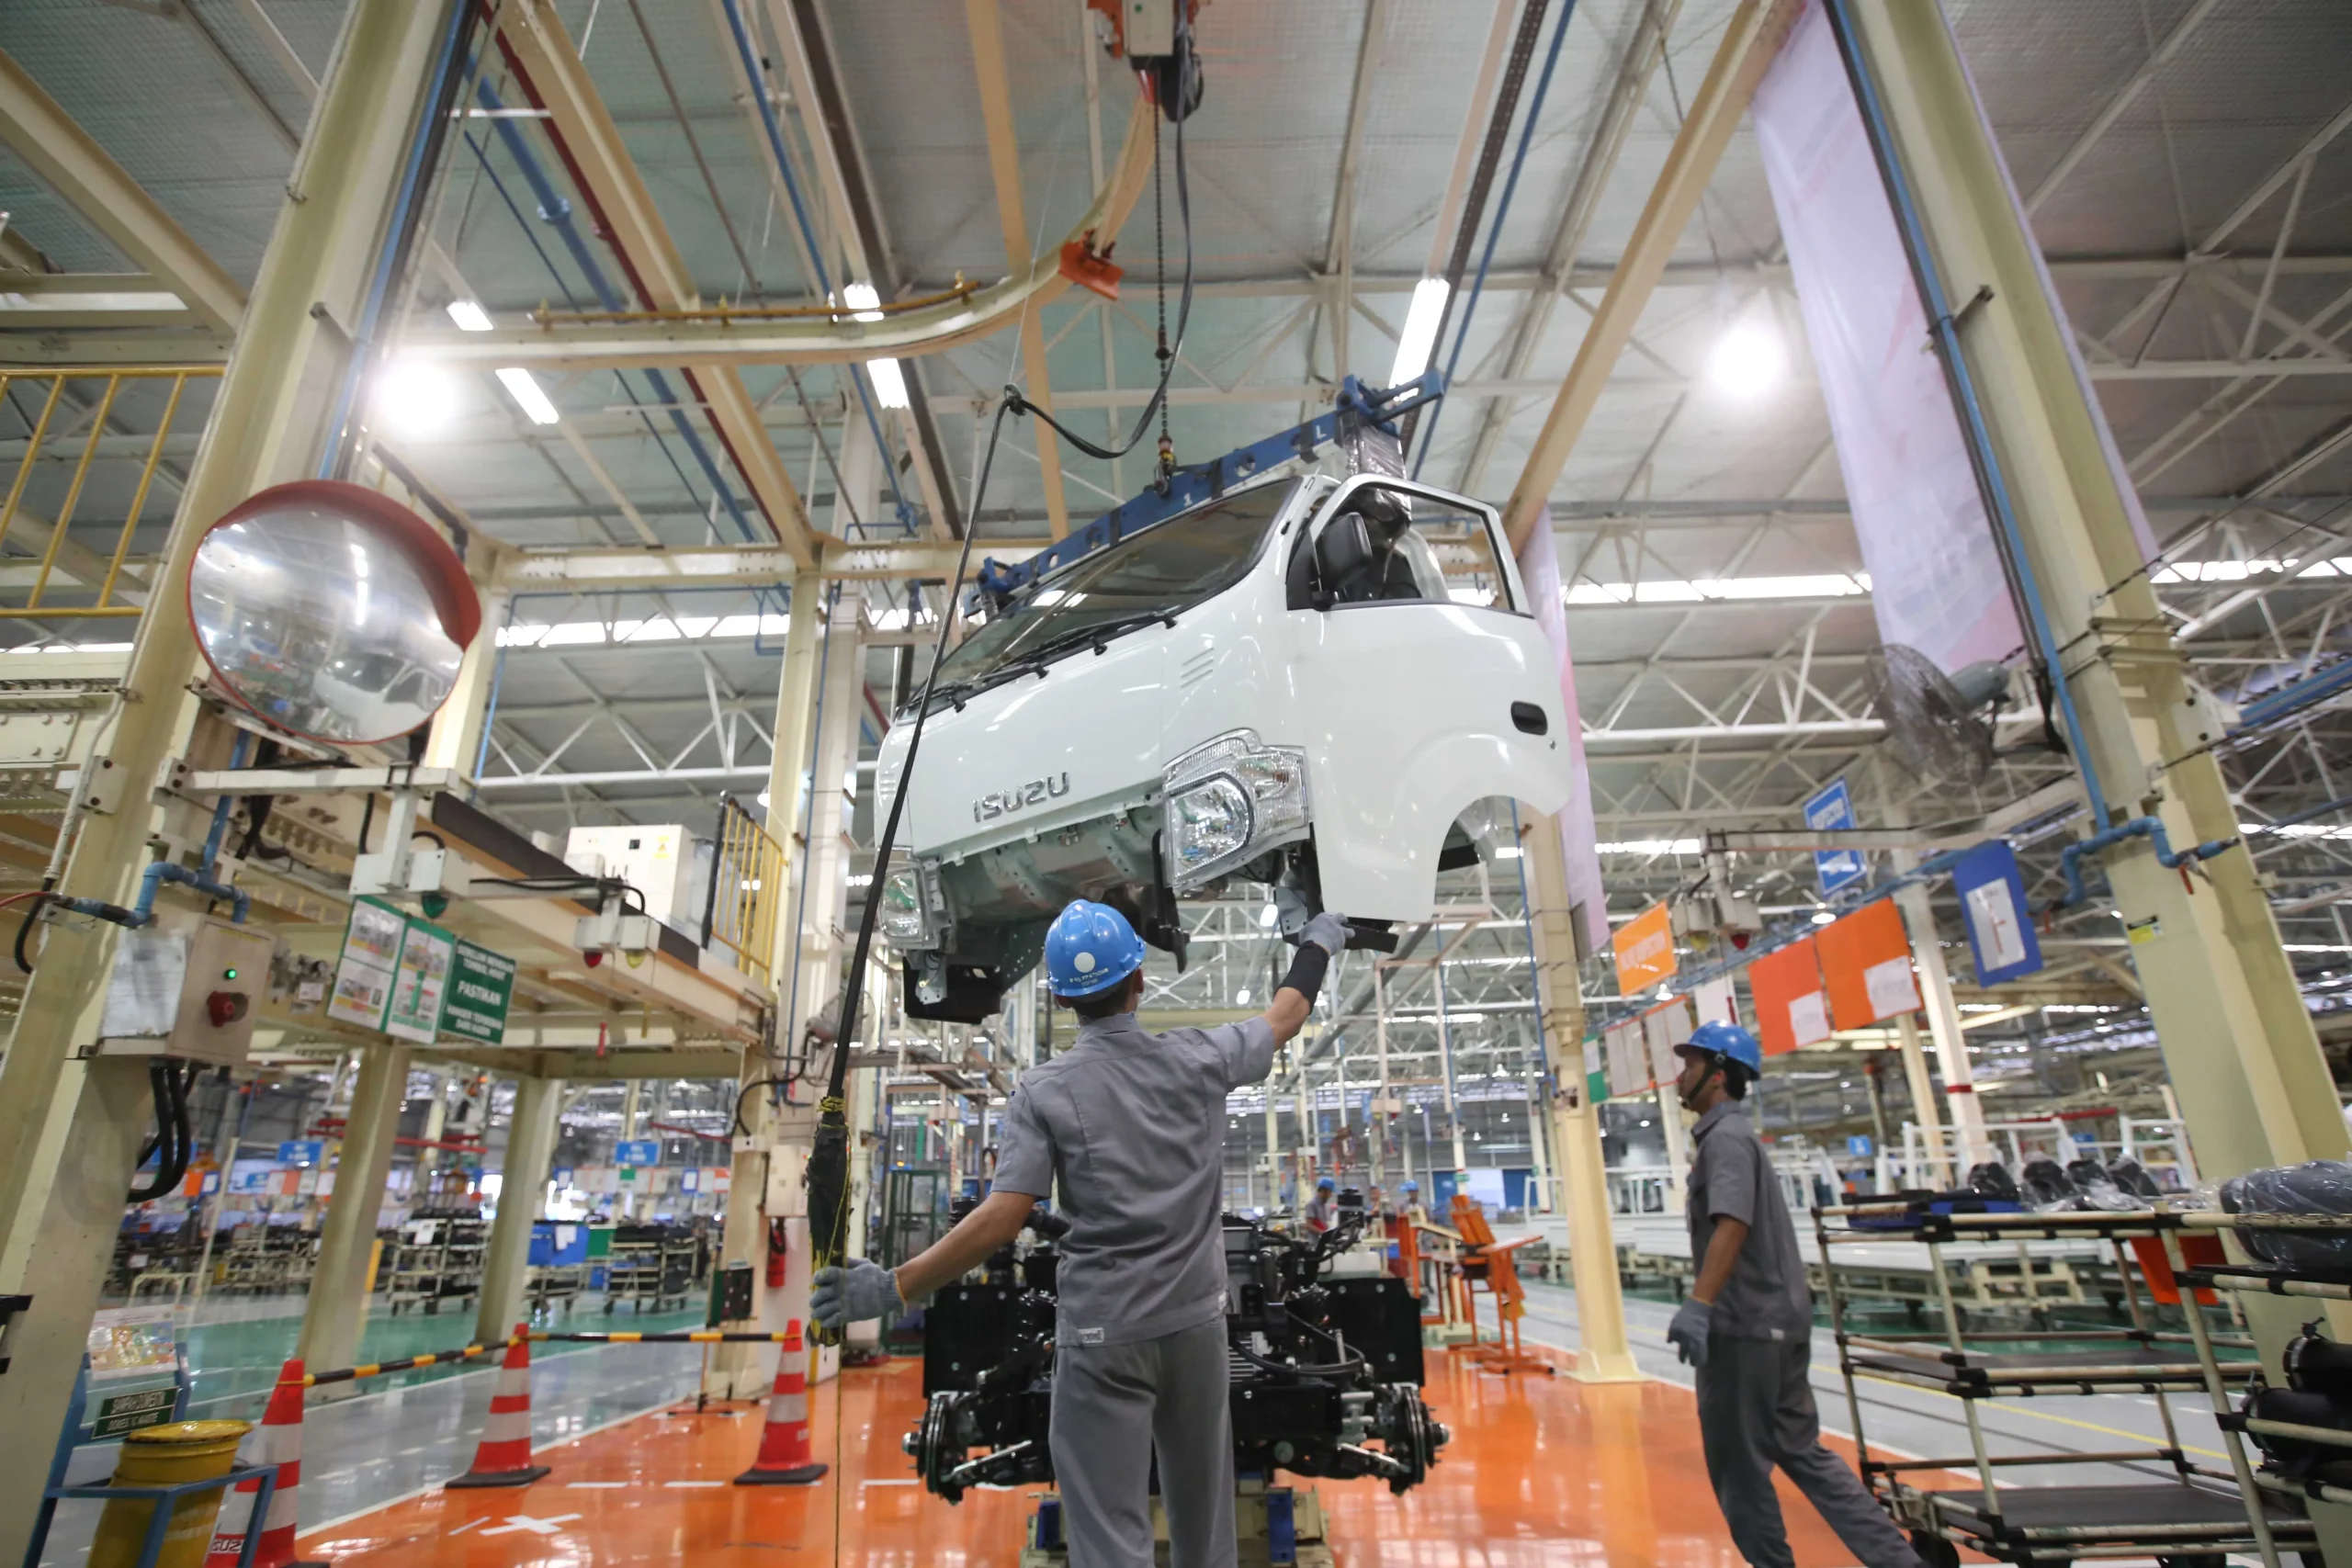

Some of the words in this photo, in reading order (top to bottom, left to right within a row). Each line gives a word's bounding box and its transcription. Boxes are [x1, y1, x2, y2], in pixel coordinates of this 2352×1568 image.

[1316, 424, 1327, 439] L
[973, 772, 1069, 822] ISUZU
[458, 980, 503, 1006] PASTIKAN
